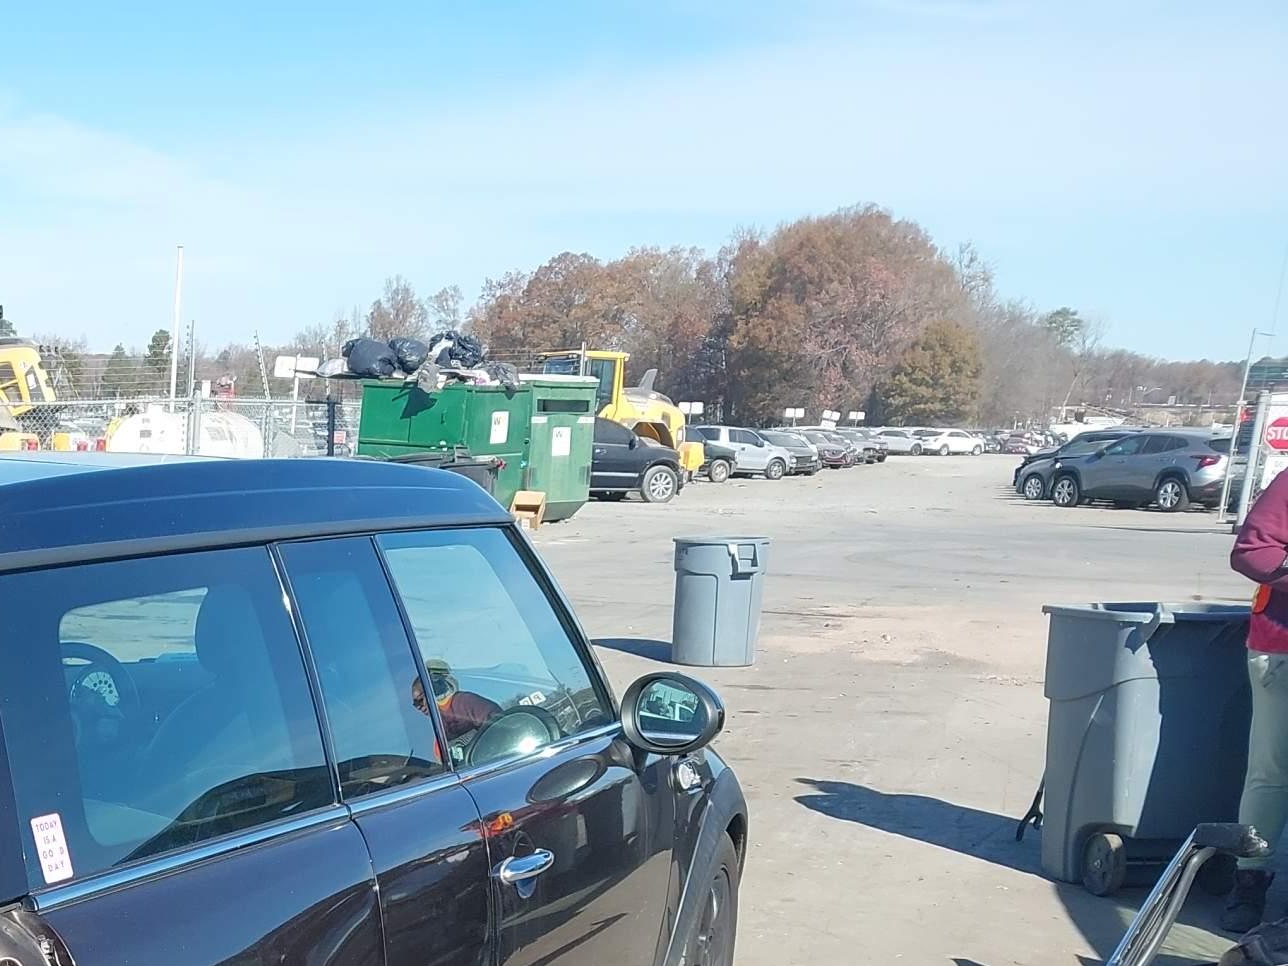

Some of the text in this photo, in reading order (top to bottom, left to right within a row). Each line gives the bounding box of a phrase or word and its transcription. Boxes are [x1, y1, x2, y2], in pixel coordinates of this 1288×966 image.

[1267, 426, 1288, 441] STO
[35, 820, 57, 832] TODAY
[43, 834, 57, 845] IS A
[47, 860, 64, 872] DAY
